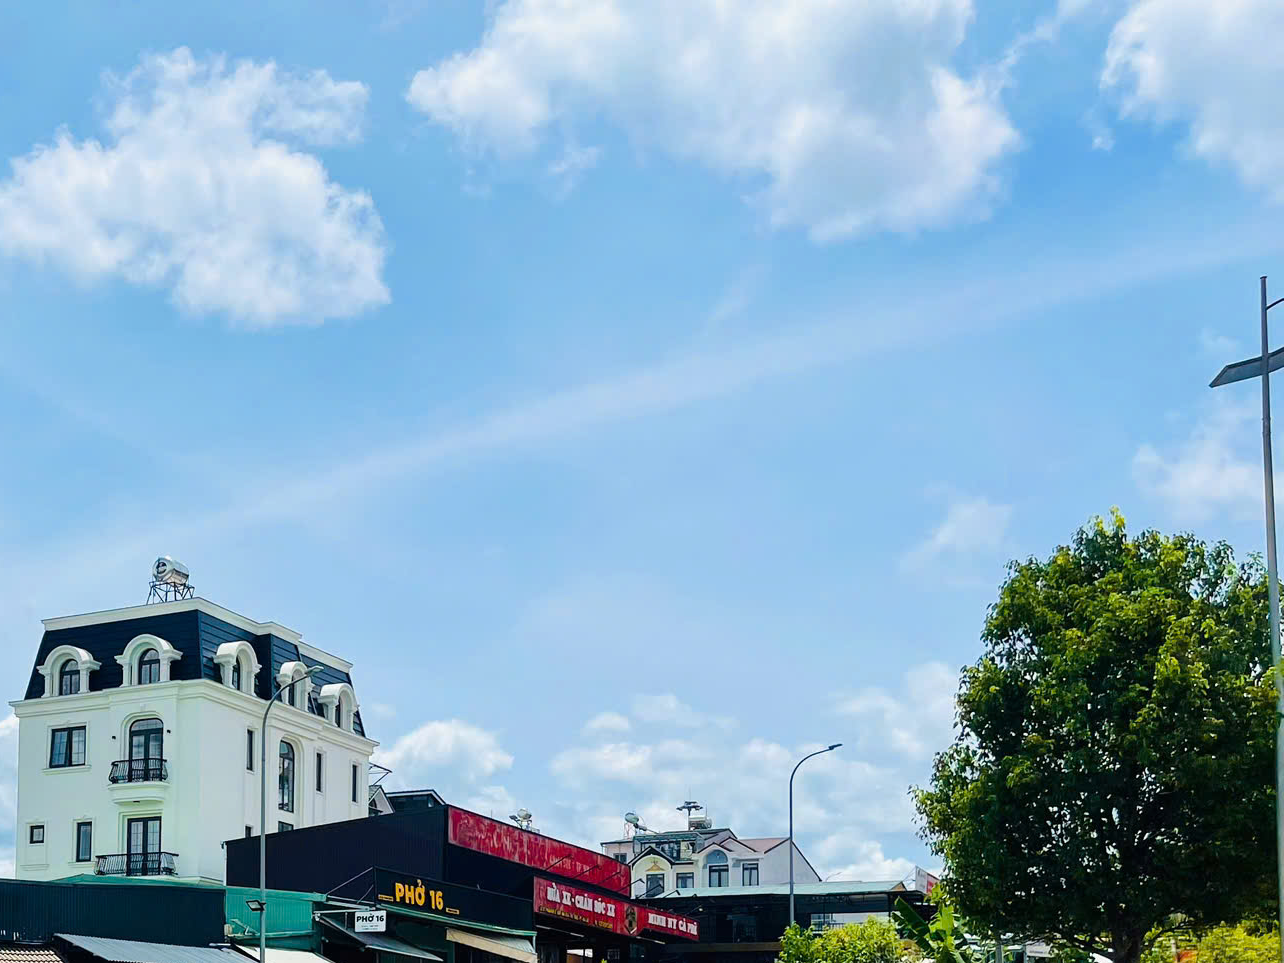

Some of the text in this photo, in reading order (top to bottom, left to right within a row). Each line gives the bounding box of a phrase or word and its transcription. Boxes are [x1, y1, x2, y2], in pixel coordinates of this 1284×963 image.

[395, 879, 444, 910] PHỞ 16
[356, 913, 374, 922] PHỞ
